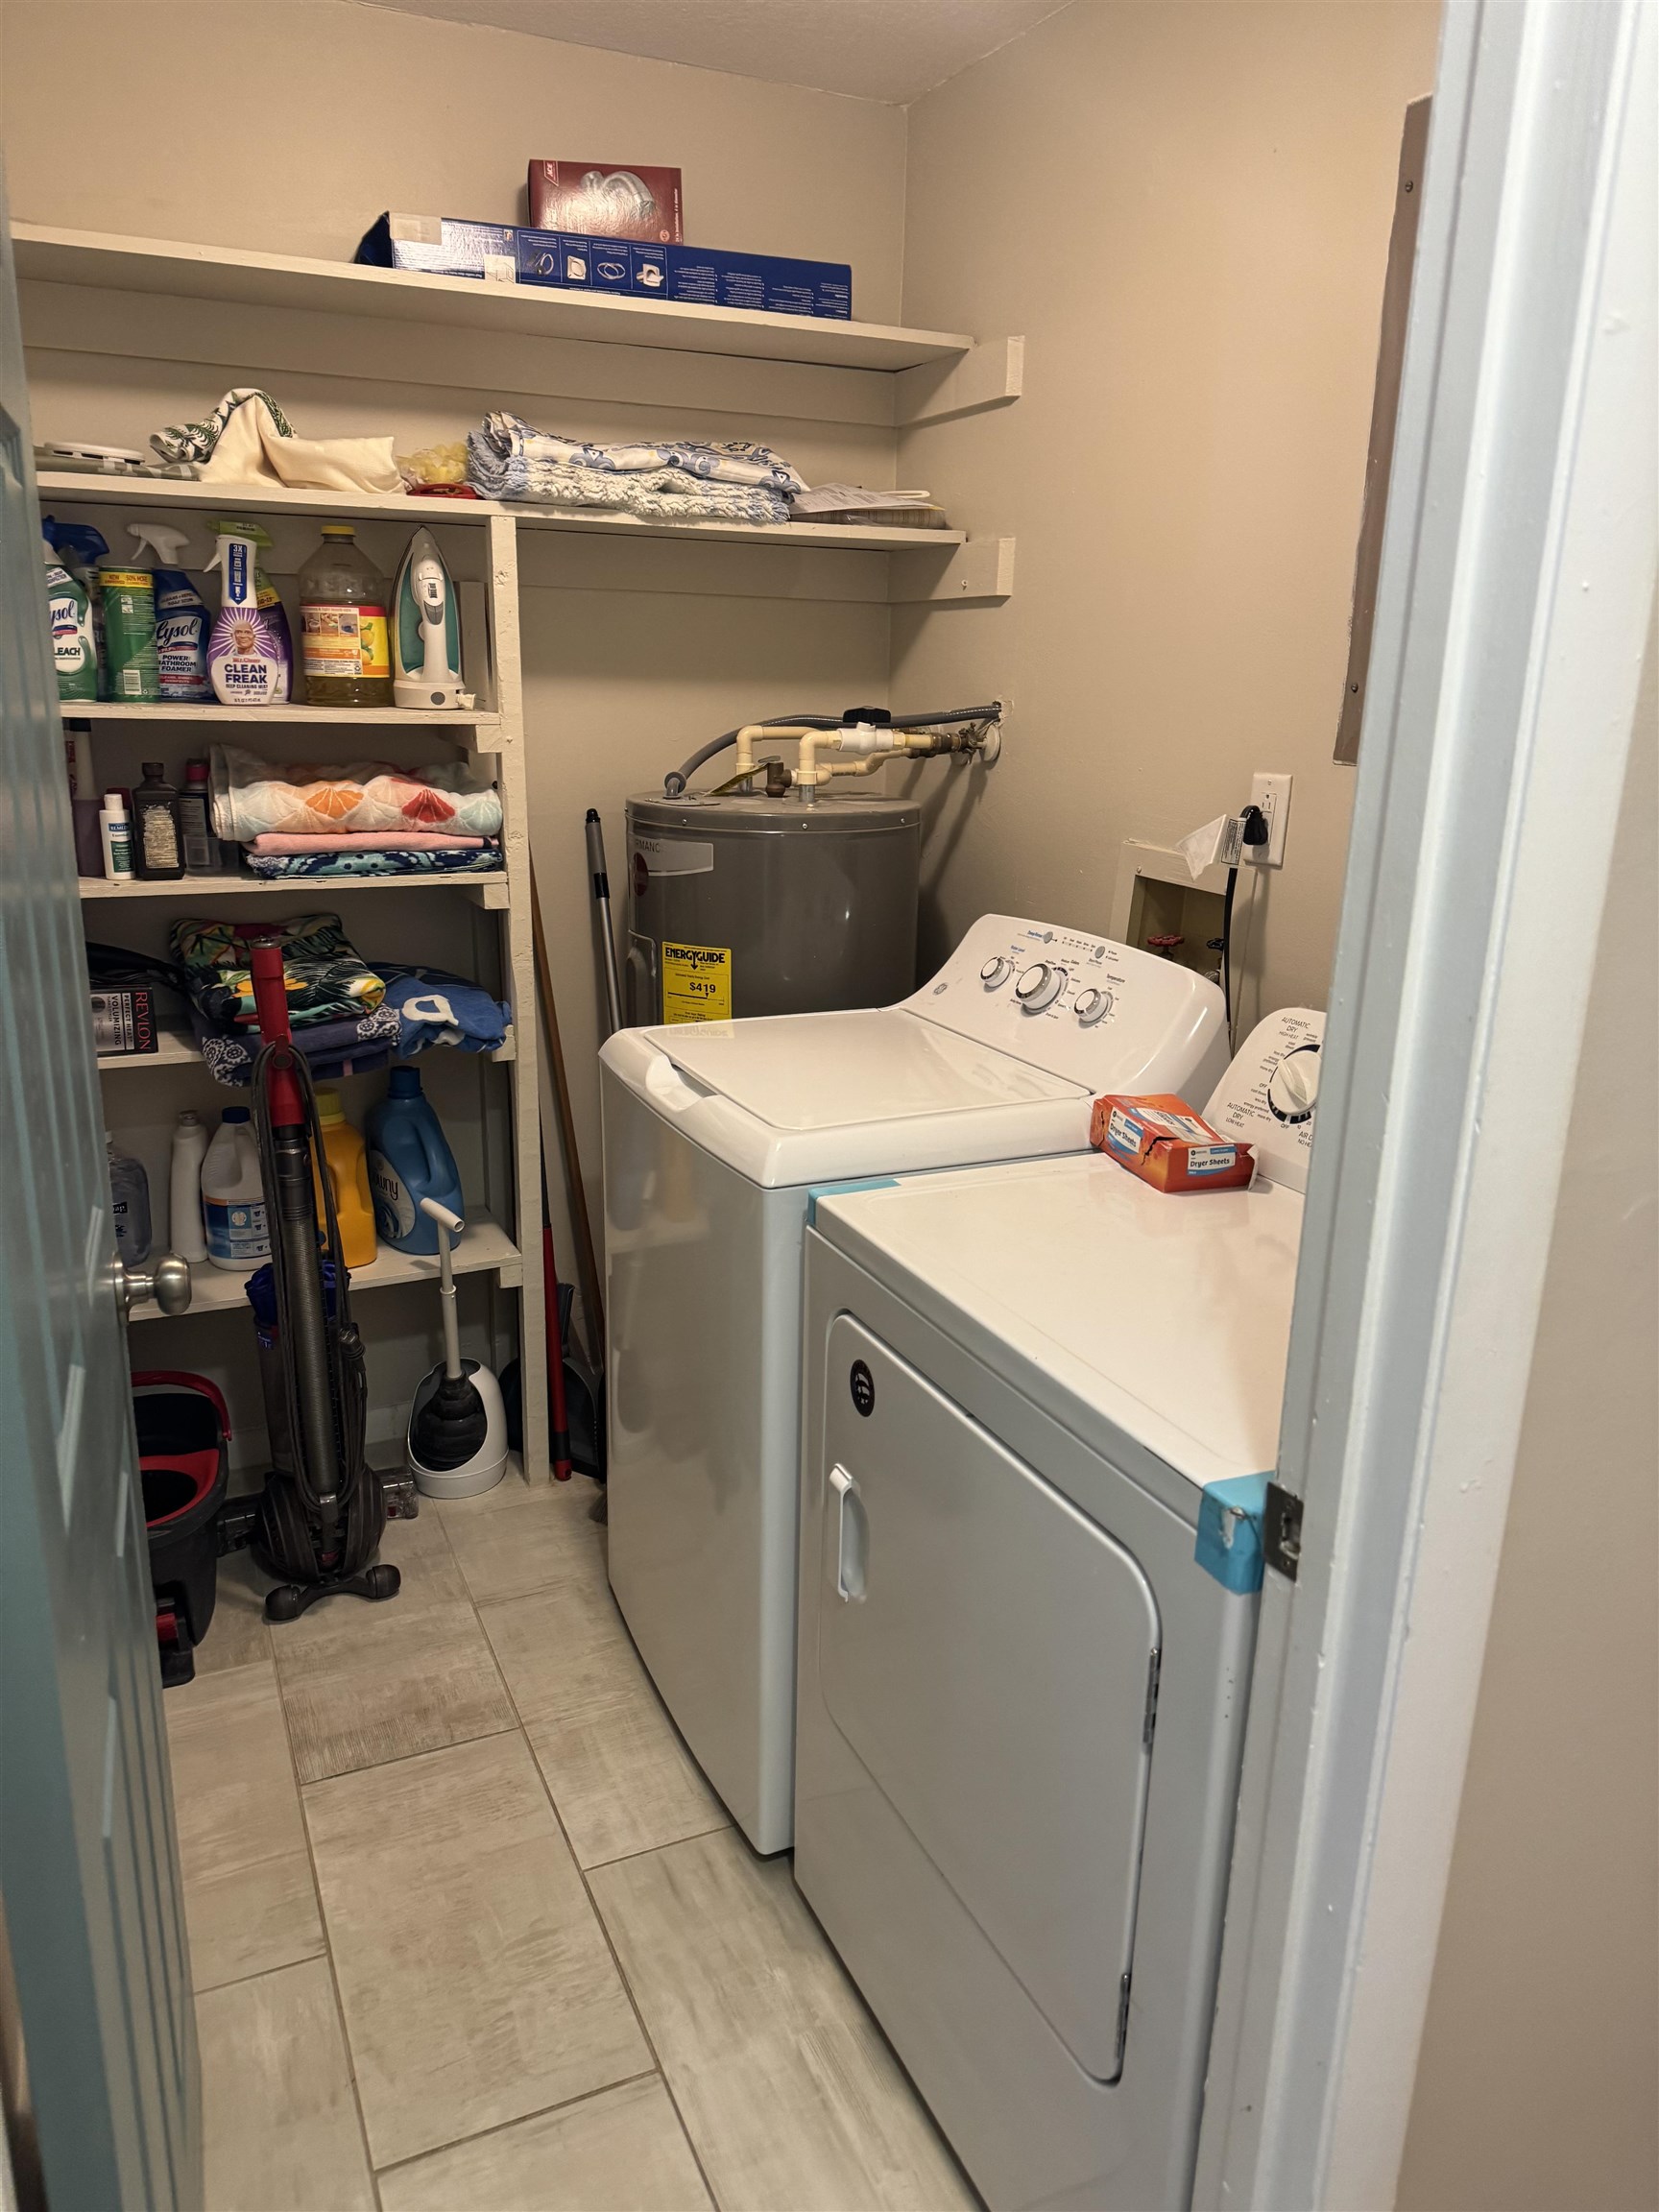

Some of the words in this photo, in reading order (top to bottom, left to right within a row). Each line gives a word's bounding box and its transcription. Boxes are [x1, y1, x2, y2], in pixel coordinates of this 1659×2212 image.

[50, 600, 75, 626] ysol
[156, 617, 199, 646] Lysol
[54, 647, 81, 656] EACH
[224, 663, 267, 674] CLEAN
[226, 674, 268, 684] FREAK
[665, 947, 726, 964] ENERGYGUIDE
[689, 981, 716, 994] $419
[111, 995, 122, 1046] VOLUMIZING
[135, 992, 151, 1049] REVLON
[1282, 1017, 1311, 1029] AUTOMATIC
[1227, 1102, 1256, 1118] AUTOMATIC
[1232, 1112, 1243, 1120] DRY
[1110, 1123, 1121, 1138] Dryer
[1121, 1130, 1137, 1147] Sheets
[1298, 1130, 1309, 1140] AIR
[1190, 1160, 1208, 1168] Dryer
